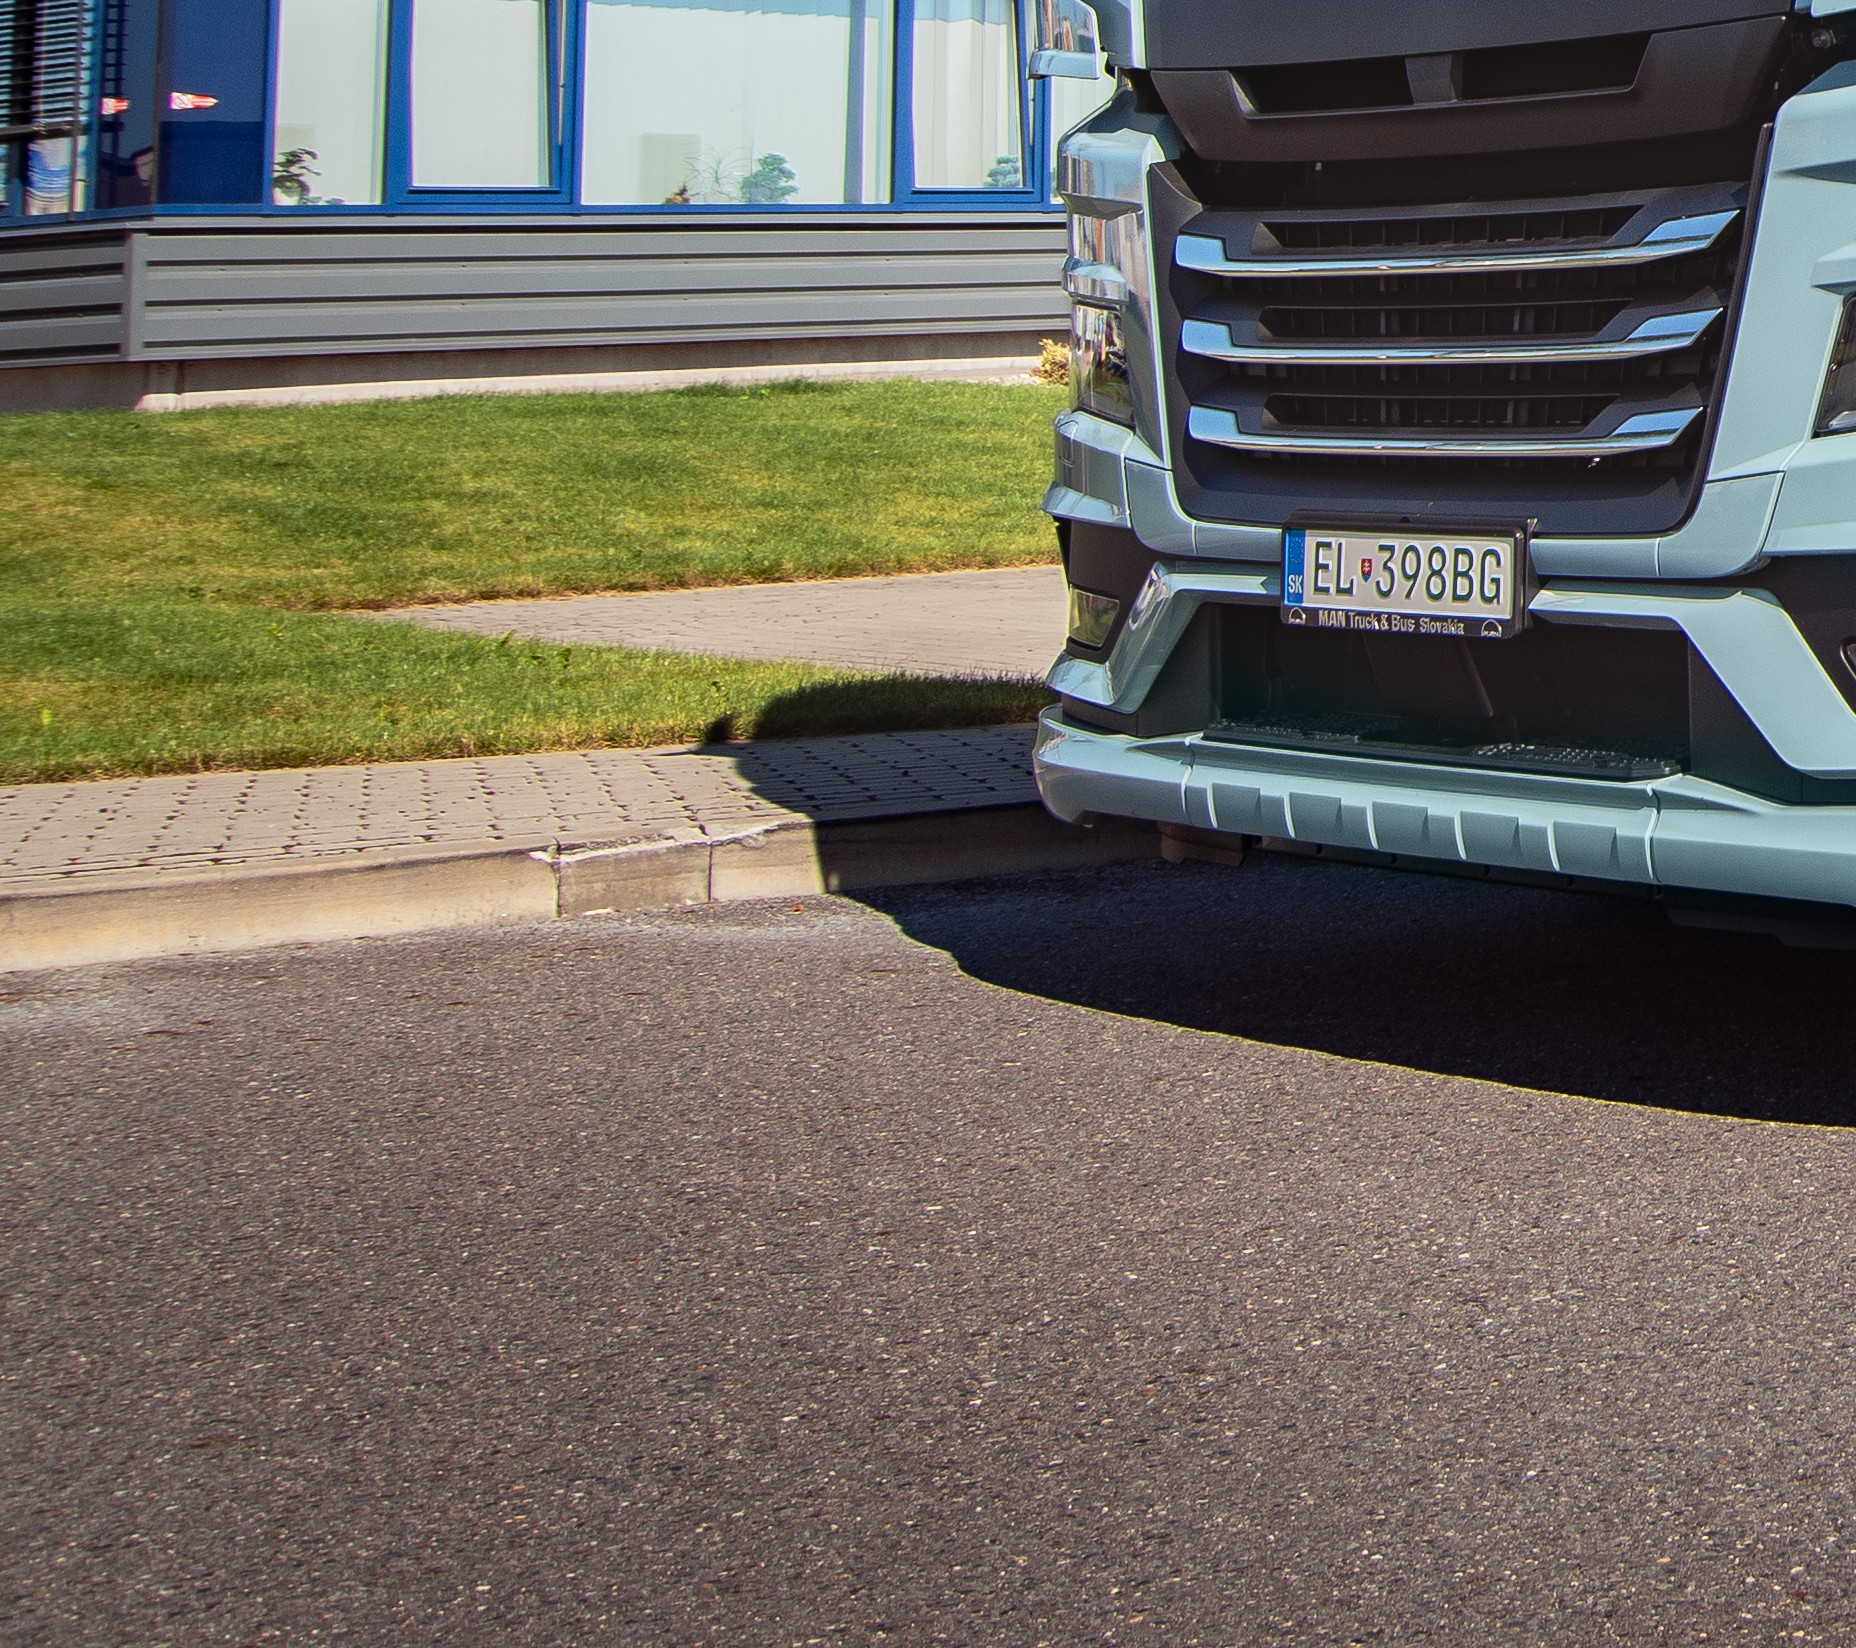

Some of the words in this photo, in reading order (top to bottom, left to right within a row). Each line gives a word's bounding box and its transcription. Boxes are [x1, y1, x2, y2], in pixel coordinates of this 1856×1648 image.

[1288, 573, 1303, 595] SK
[1313, 540, 1356, 597] EL
[1375, 542, 1503, 606] 398BG
[1318, 609, 1346, 629] MAN
[1349, 611, 1379, 631] Truck
[1380, 615, 1389, 631] &
[1391, 614, 1416, 633] Bus
[1419, 617, 1465, 635] Slovakia
